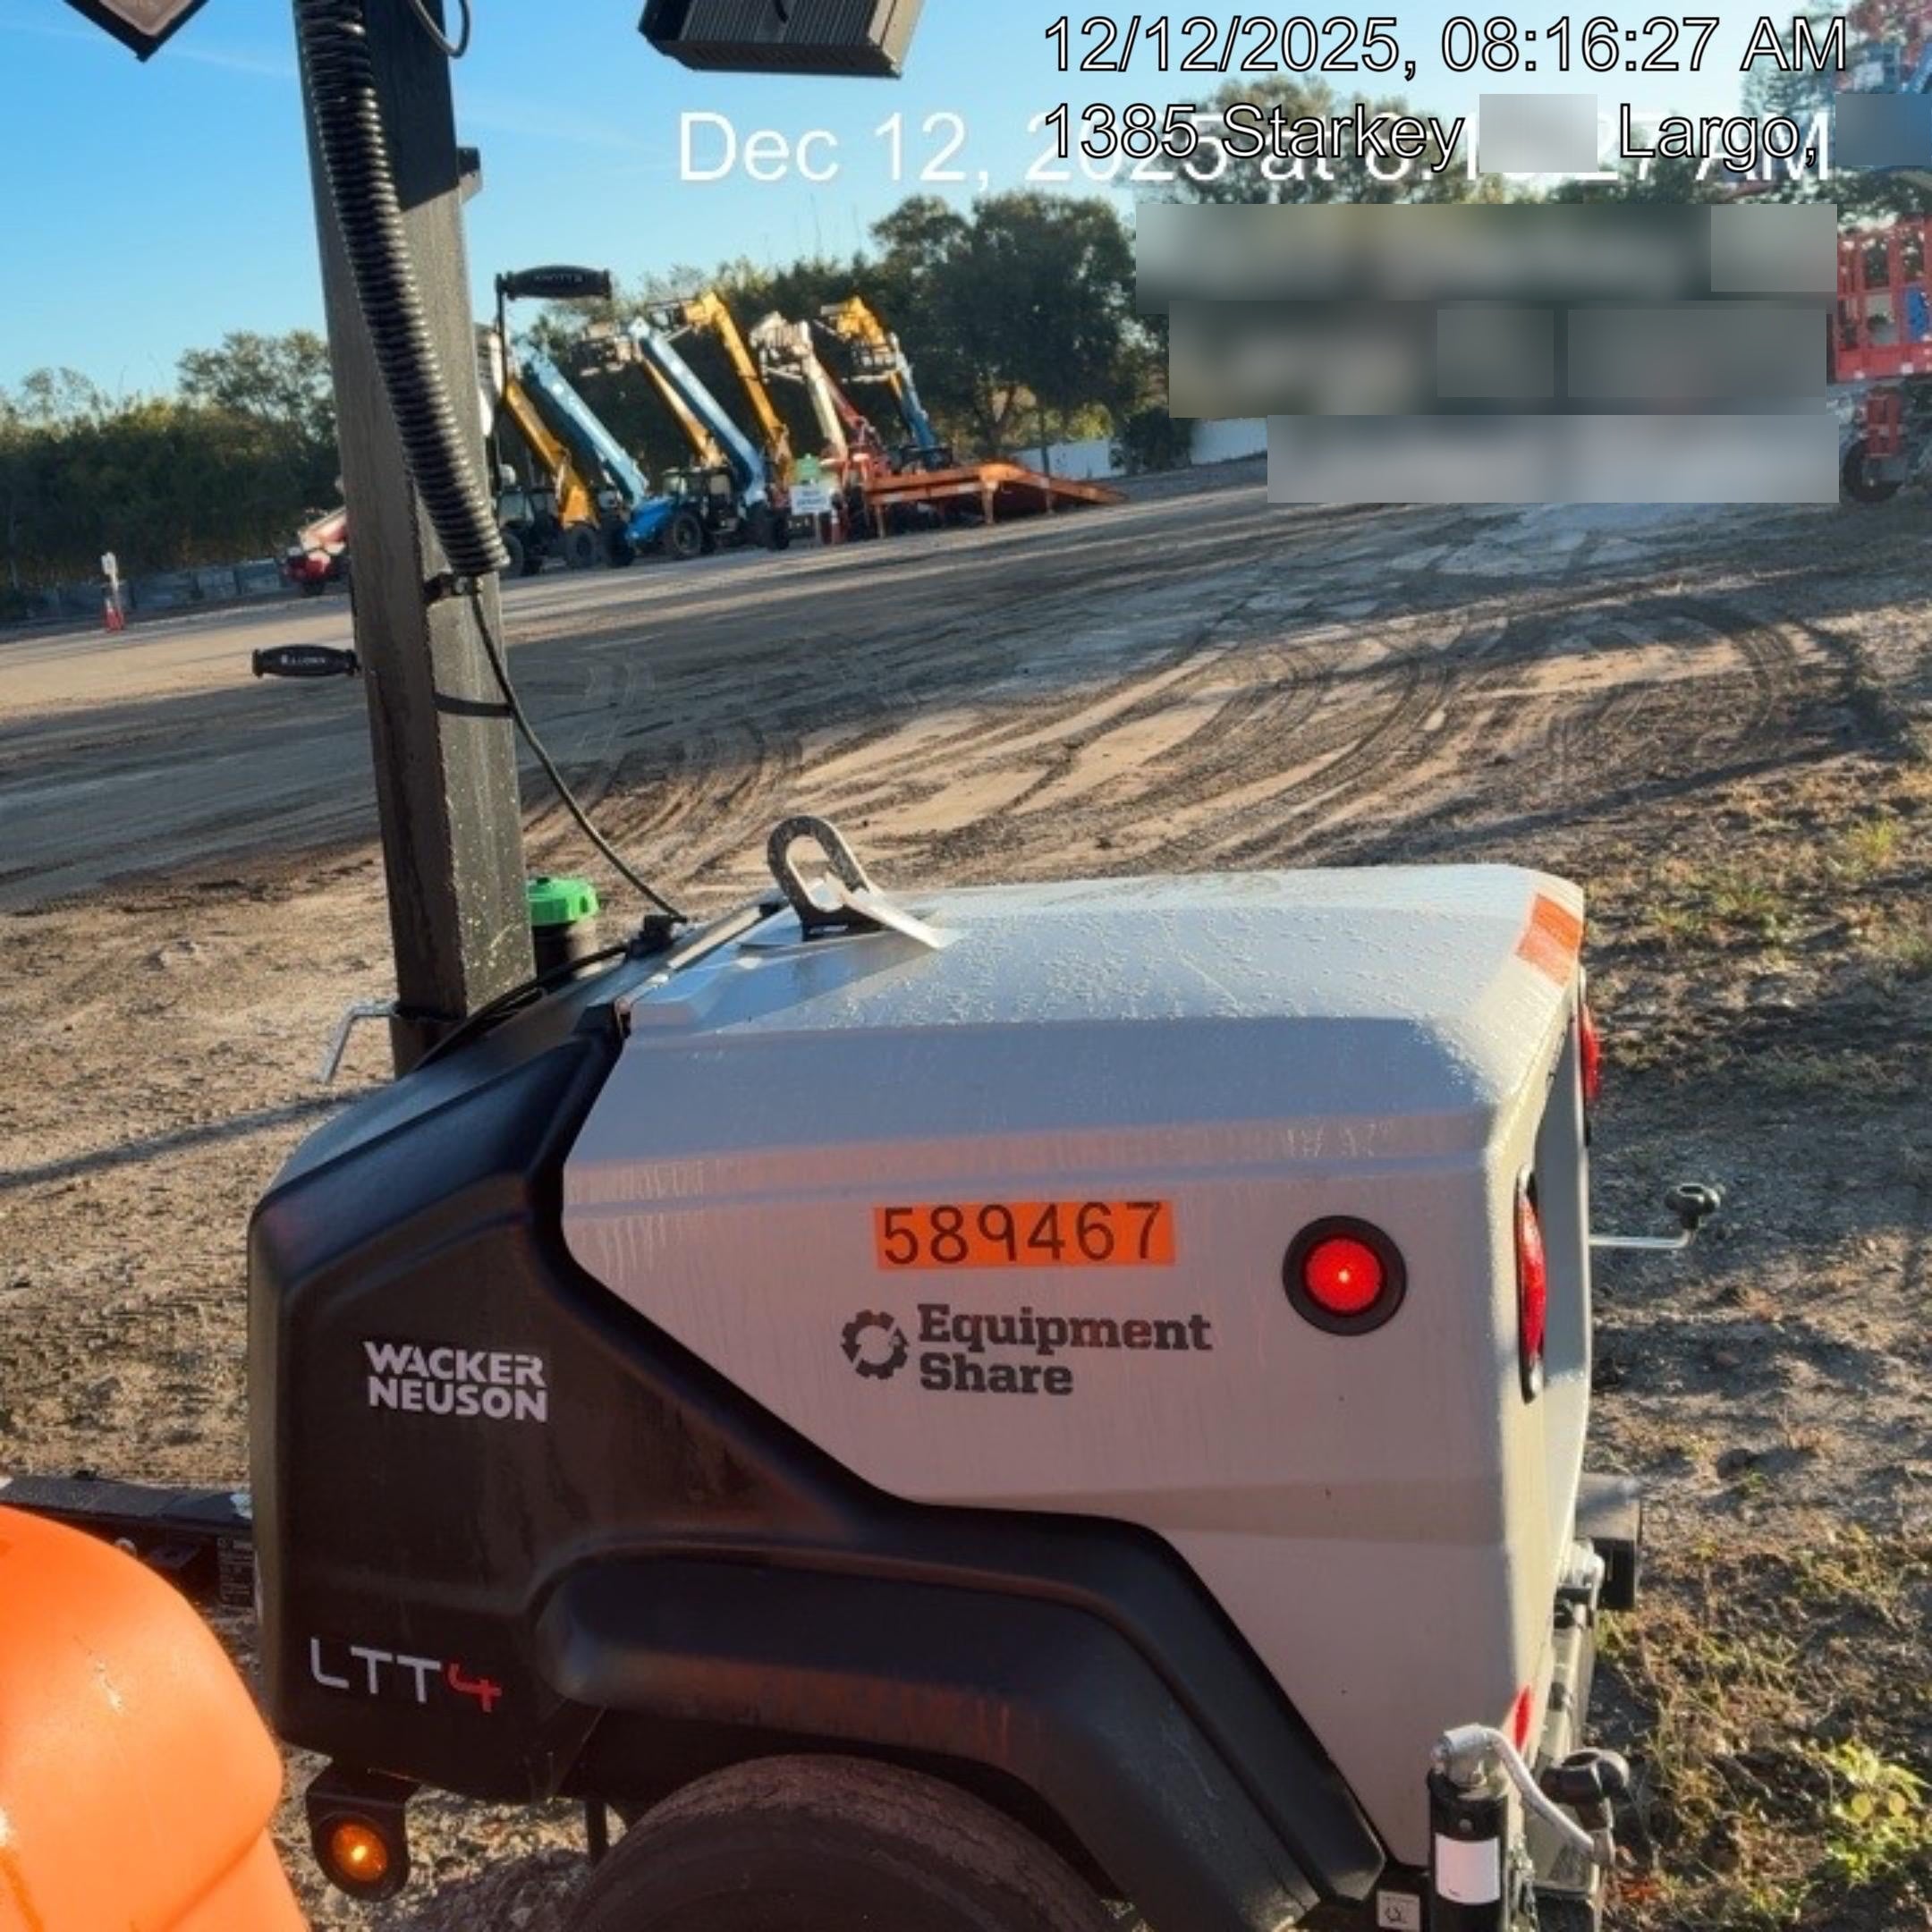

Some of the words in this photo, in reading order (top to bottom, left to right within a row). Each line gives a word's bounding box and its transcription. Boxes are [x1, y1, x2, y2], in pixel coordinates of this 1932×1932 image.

[884, 1200, 1161, 1265] 589467
[917, 1302, 1214, 1356] Equipment
[363, 1341, 547, 1388] WACKER
[919, 1352, 1072, 1396] Share
[369, 1376, 548, 1424] NEUSON
[309, 1637, 503, 1713] LTT4
